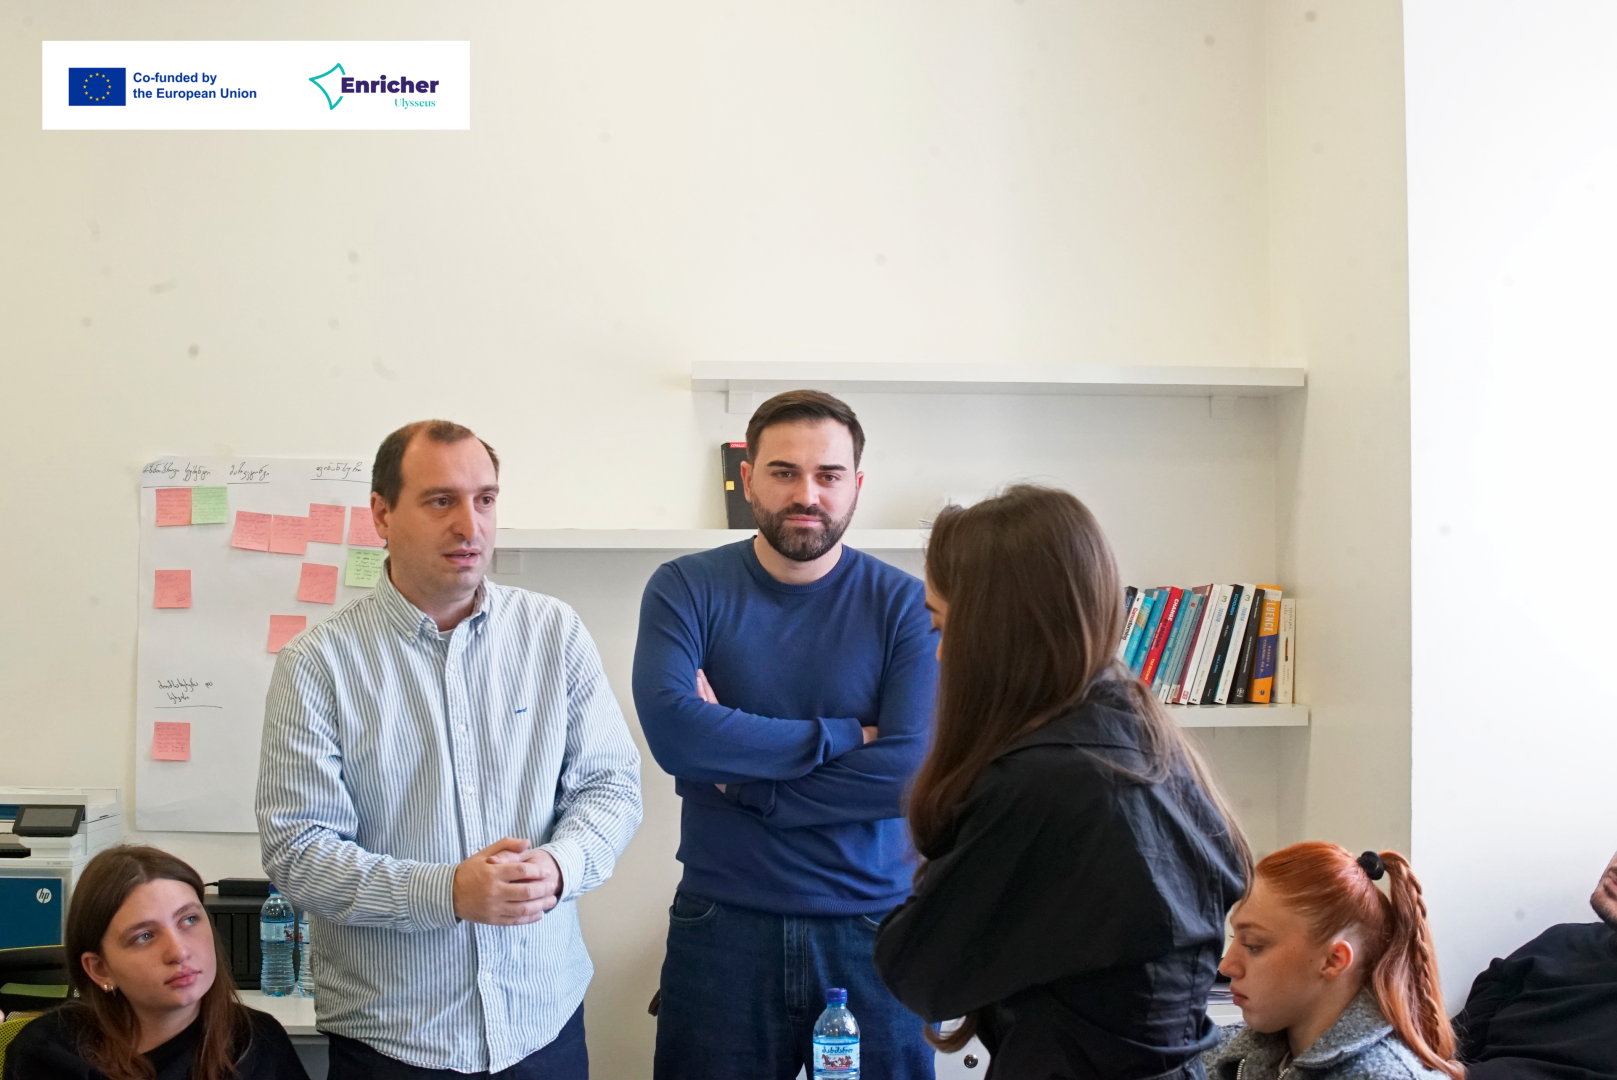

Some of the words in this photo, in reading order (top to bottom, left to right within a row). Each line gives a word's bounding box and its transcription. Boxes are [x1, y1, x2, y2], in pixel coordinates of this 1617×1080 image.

[1168, 598, 1179, 622] CHANGE
[1122, 607, 1138, 641] Gamestorming
[1155, 626, 1166, 649] DESIGN
[39, 888, 50, 904] hp
